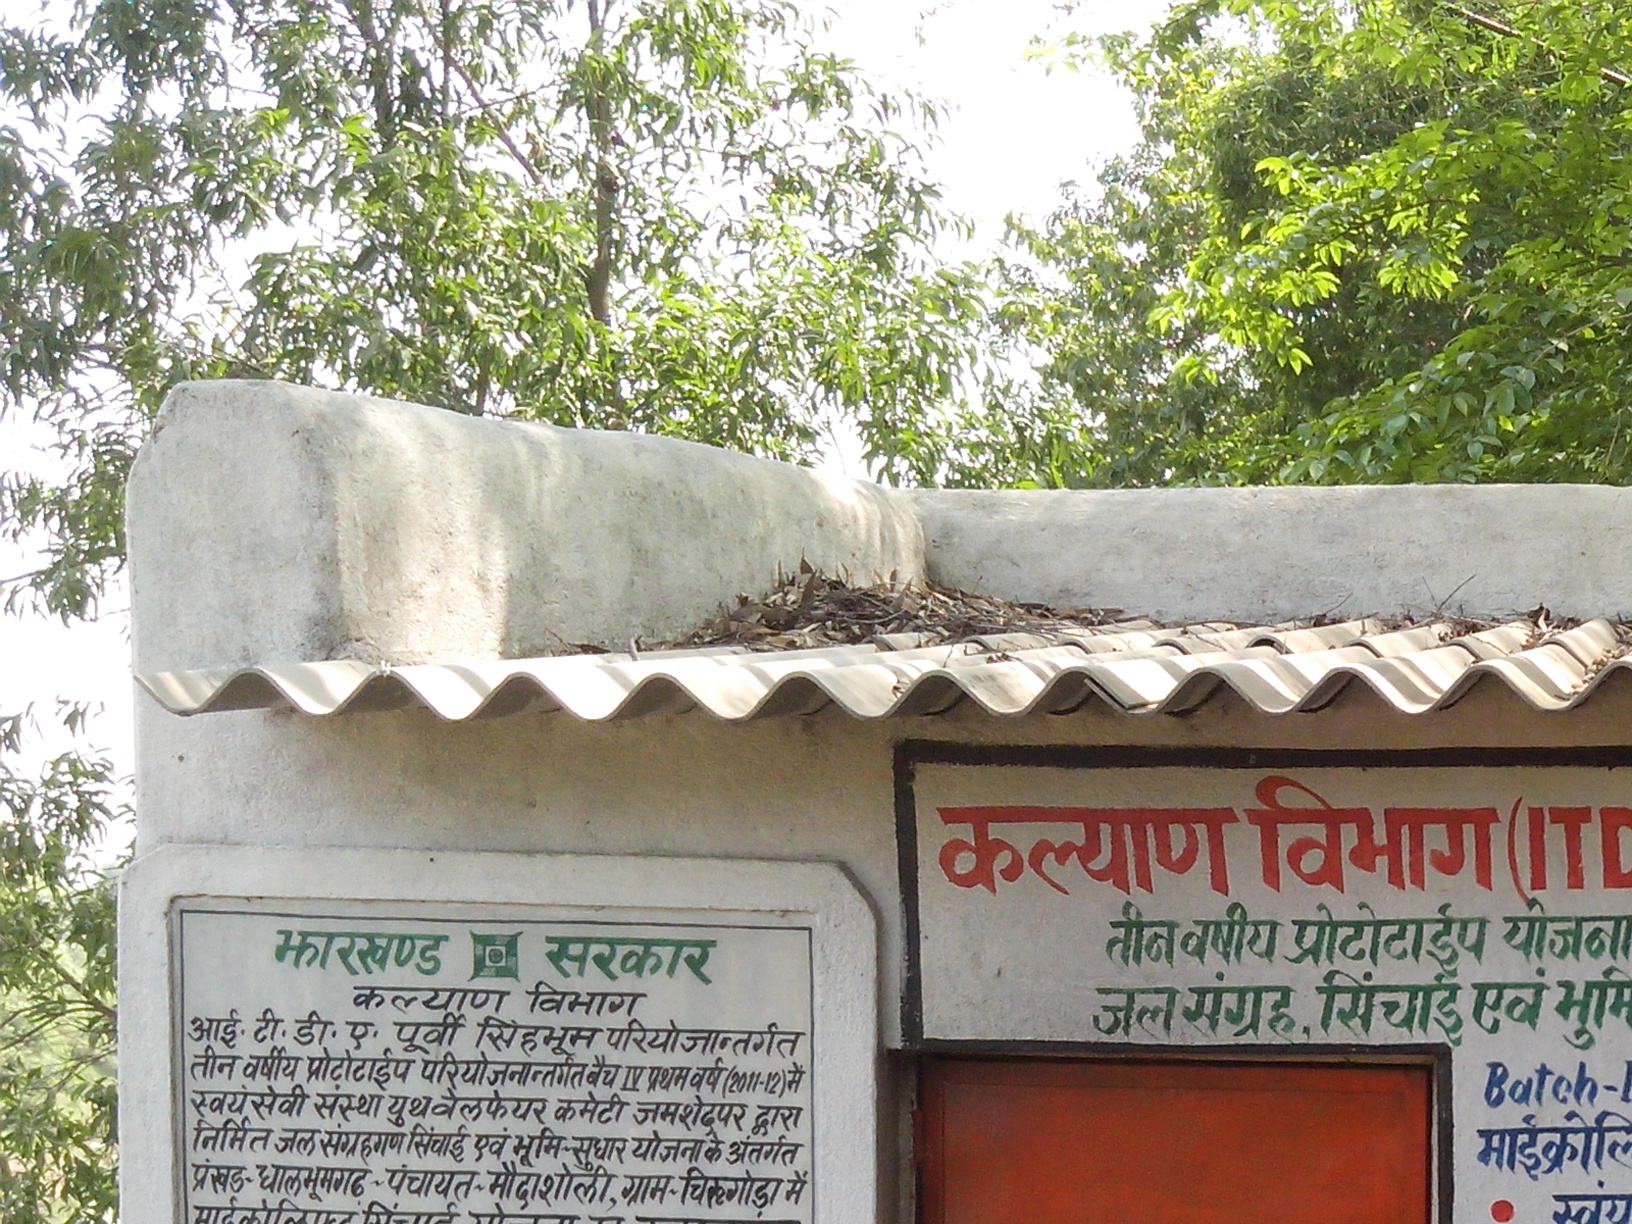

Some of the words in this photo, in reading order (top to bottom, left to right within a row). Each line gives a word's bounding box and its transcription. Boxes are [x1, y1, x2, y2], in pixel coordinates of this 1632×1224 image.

[936, 805, 1240, 896] कल्याण
[1242, 774, 1501, 895] विभाग
[275, 929, 449, 976] झारखण्ड
[545, 935, 717, 985] सरकार
[1105, 900, 1181, 967] तीन
[1285, 902, 1490, 972] प्रोटोटाईप
[353, 985, 510, 1014] कल्याण
[526, 980, 647, 1016] विभाग
[1092, 986, 1181, 1036] जल
[1315, 970, 1462, 1047] सिंचाई
[1472, 967, 1550, 1036] एवं
[393, 1011, 467, 1055] पूर्वी
[190, 1046, 243, 1081] तीन
[588, 1055, 622, 1089] बैच
[648, 1066, 692, 1094] प्रथम
[690, 1057, 728, 1094] वर्ष
[787, 1062, 806, 1094] में
[315, 1084, 384, 1122] संस्था
[554, 1091, 630, 1124] कमेटी
[751, 1104, 803, 1137] द्वारा
[193, 1117, 275, 1152] निर्मित
[275, 1129, 320, 1157] जल
[406, 1125, 472, 1163] सिंचाई
[474, 1127, 509, 1162] एवं
[631, 1130, 703, 1163] योजना
[703, 1133, 725, 1162] के
[725, 1134, 805, 1166] अंतर्गत
[783, 1170, 808, 1205] में
